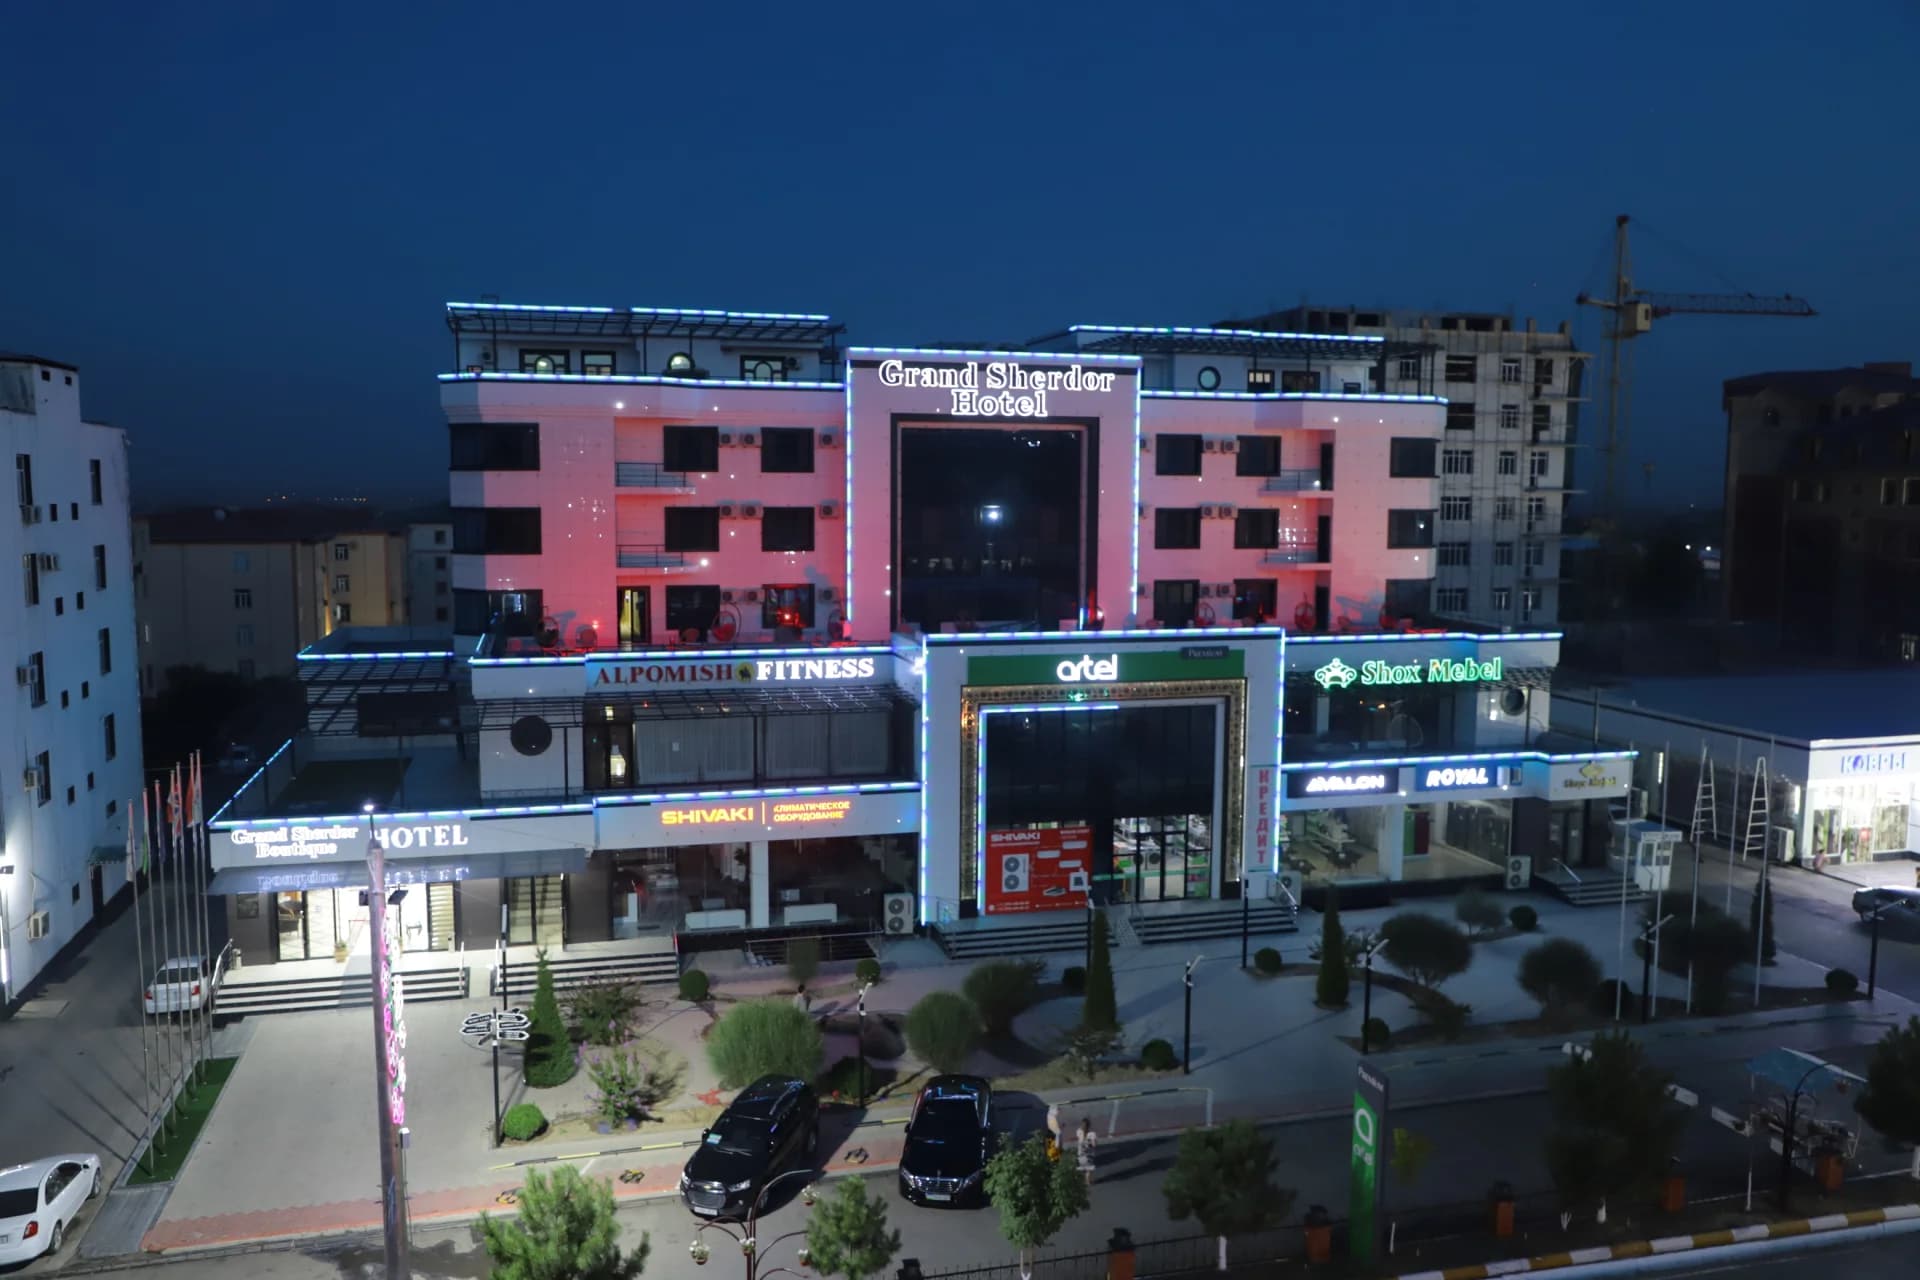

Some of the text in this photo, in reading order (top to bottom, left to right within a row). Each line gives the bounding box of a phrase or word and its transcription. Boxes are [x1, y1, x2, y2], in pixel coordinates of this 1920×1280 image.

[879, 360, 1115, 392] Grand Sherdor
[951, 389, 1048, 416] Hotel
[596, 657, 875, 684] ALPOMISH FITNESS
[1056, 654, 1118, 682] artel
[1360, 656, 1502, 685] Shox Mebel
[1425, 767, 1489, 788] ROYAL
[661, 807, 754, 825] SHIVAKI
[773, 801, 851, 813] КЛИМАТИЧЕСКОЕ
[773, 811, 844, 822] ОБОРУДОВАНИЕ
[231, 825, 359, 844] Grand Sherdor
[990, 832, 1041, 842] SHIVAKI
[255, 839, 338, 858] Boutique
